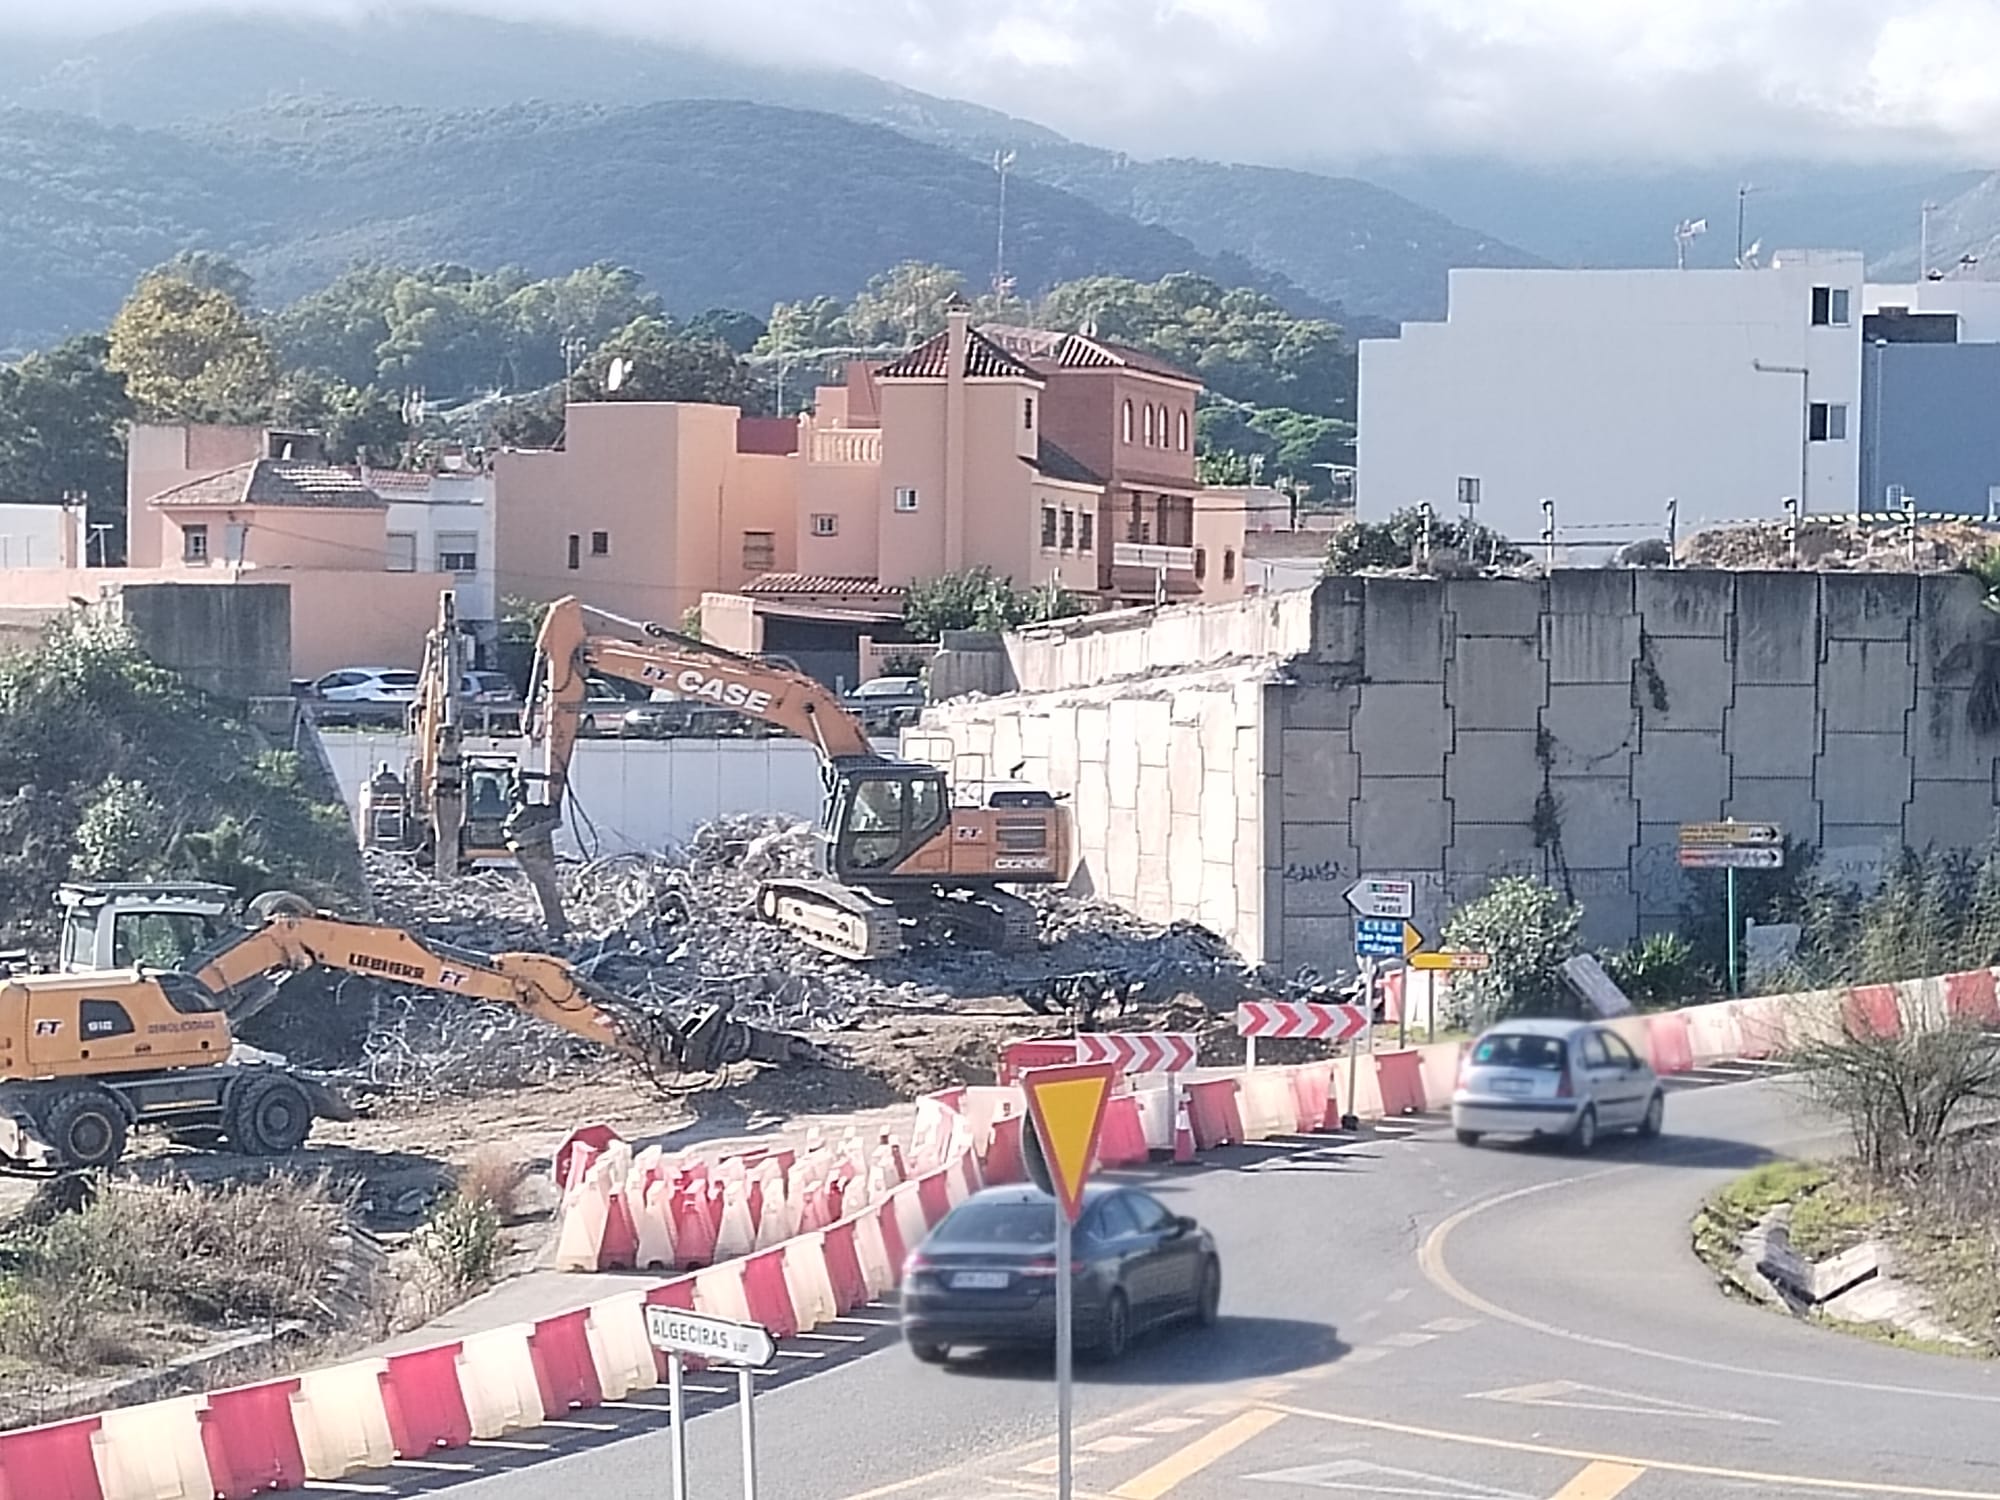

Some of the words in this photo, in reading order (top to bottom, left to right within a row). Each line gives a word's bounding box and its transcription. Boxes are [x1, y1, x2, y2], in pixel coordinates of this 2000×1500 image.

[677, 670, 772, 713] CASE
[440, 970, 467, 987] FT
[36, 1020, 63, 1036] FT
[653, 1319, 728, 1349] ALGECIRAS
